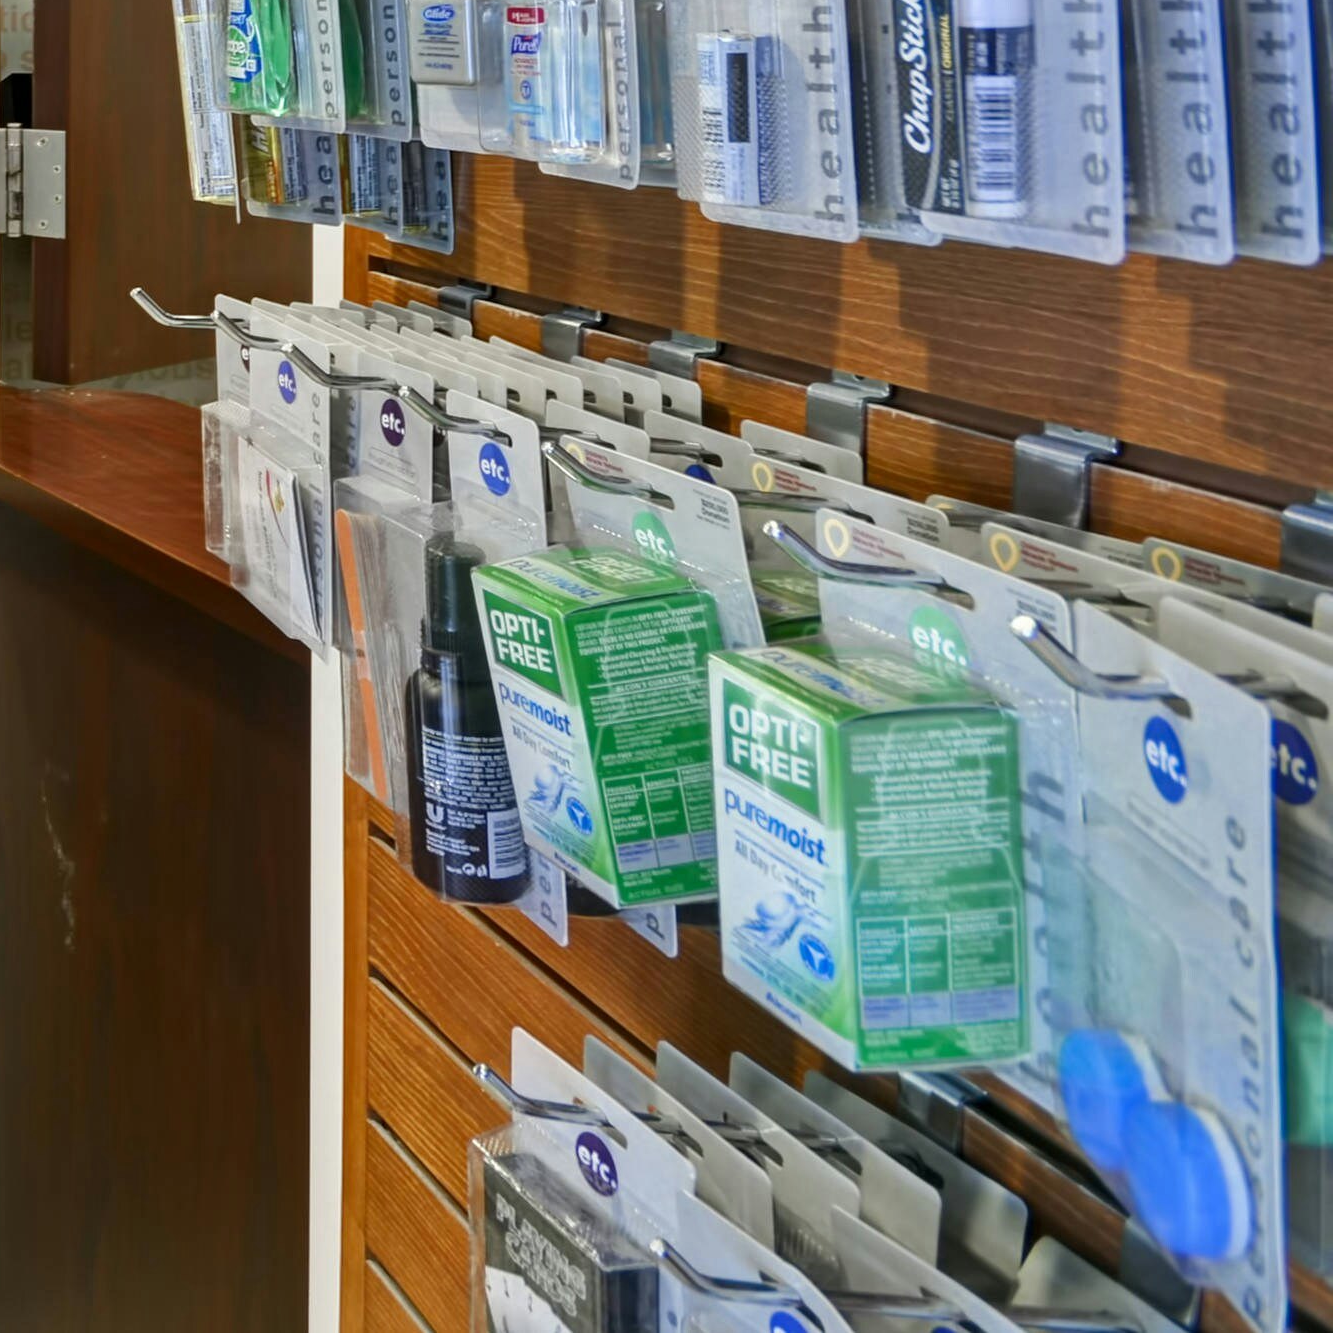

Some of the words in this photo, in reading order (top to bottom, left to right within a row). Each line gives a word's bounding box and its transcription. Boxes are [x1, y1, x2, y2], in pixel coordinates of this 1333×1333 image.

[424, 6, 453, 20] Glide
[606, 20, 633, 181] personal
[802, 2, 845, 223] health
[278, 373, 296, 394] etc.
[381, 412, 406, 435] etc.
[480, 458, 511, 485] etc.
[635, 527, 675, 557] etc.
[489, 609, 546, 646] OPTI-
[911, 624, 967, 667] etc.
[496, 637, 553, 674] FREE
[498, 681, 573, 736] puremoist
[731, 736, 813, 790] FREE
[1145, 736, 1187, 788] etc.
[724, 786, 828, 867] puremoist
[1227, 815, 1255, 972] care
[578, 1144, 618, 1190] etc.
